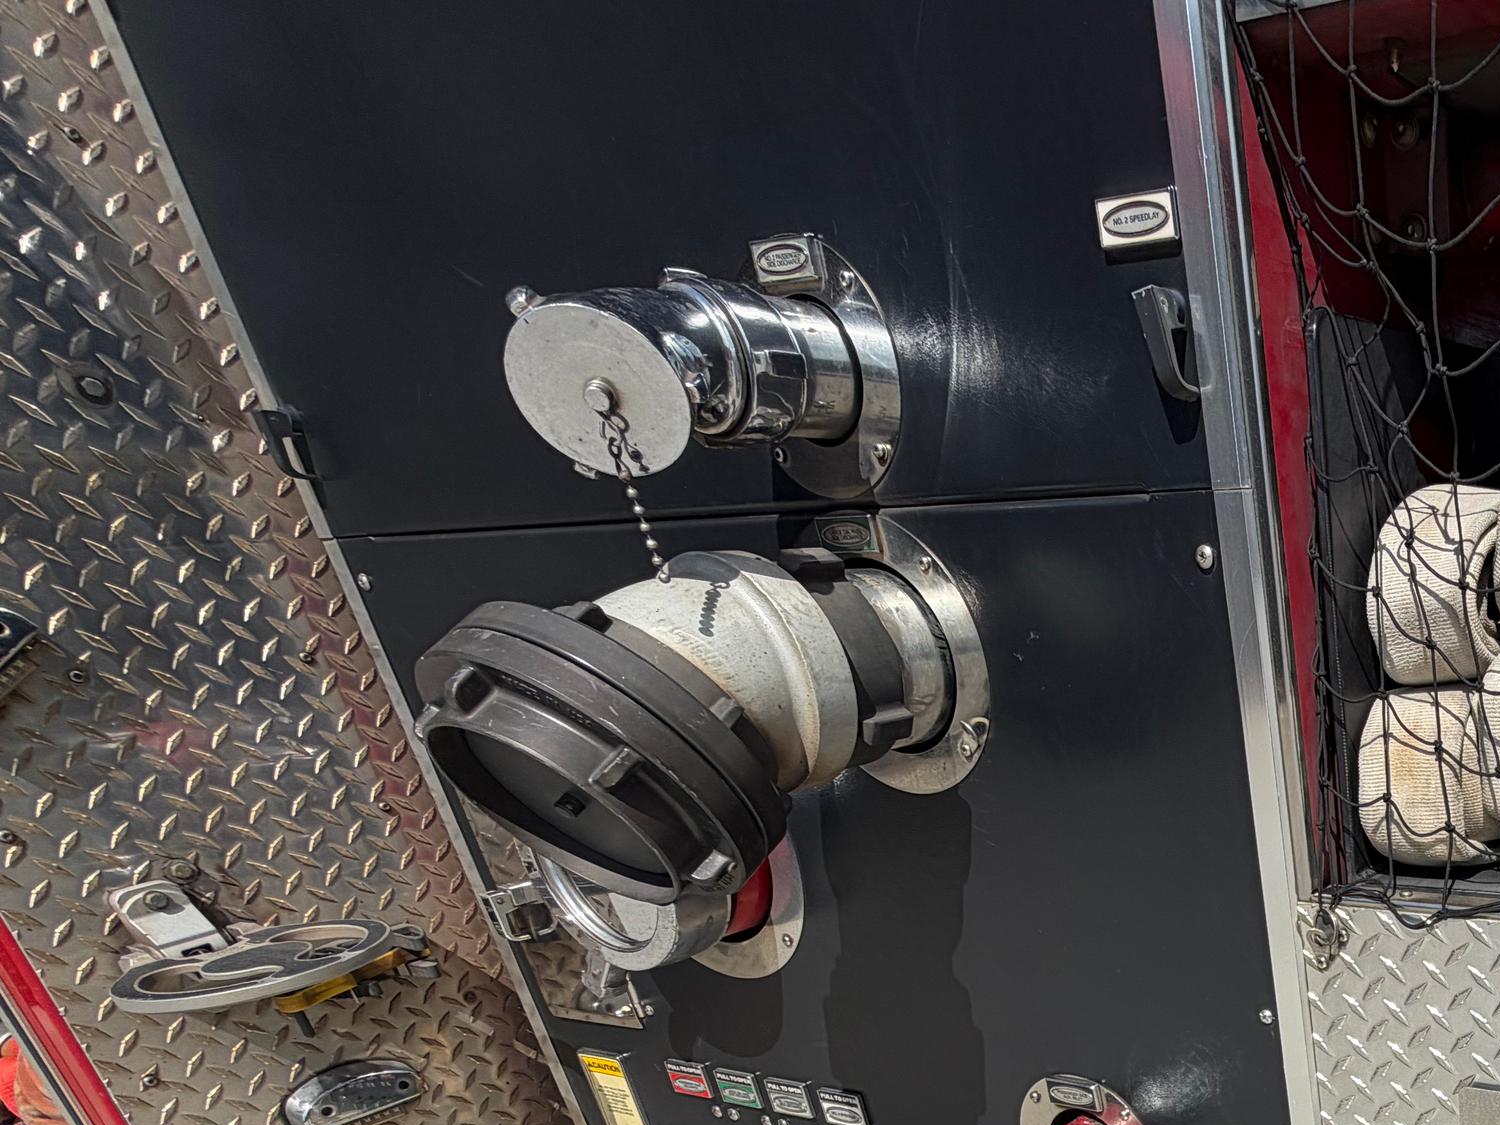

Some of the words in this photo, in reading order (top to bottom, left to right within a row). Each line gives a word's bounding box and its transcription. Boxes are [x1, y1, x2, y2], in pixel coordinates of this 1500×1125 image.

[1113, 217, 1123, 226] NO.
[1129, 212, 1159, 223] SPEEDLAY
[592, 1062, 620, 1073] CAUTION
[667, 1063, 679, 1071] PULL
[687, 1066, 702, 1075] OPEN
[716, 1072, 729, 1080] PULL
[736, 1075, 751, 1084] OPEN
[767, 1083, 780, 1091] PULL
[788, 1086, 802, 1094] OPEN
[820, 1092, 834, 1100] PULL
[842, 1096, 858, 1105] OPEN
